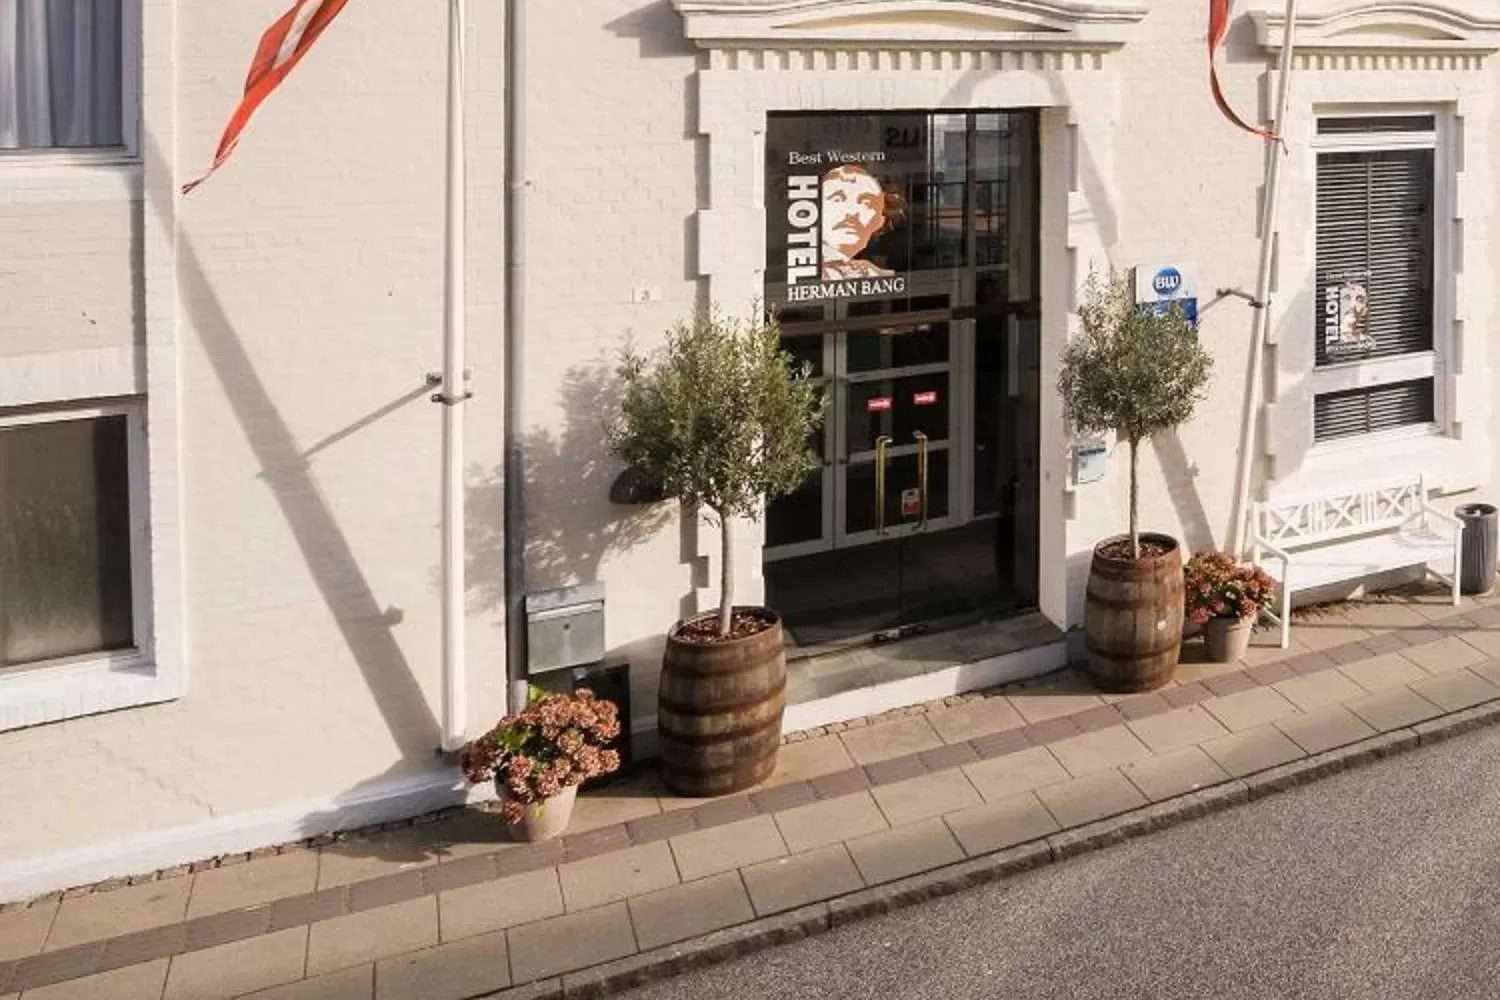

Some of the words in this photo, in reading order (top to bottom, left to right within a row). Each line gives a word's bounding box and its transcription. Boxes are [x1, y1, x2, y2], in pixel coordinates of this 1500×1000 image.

[788, 151, 822, 165] Best
[826, 150, 885, 164] Western
[787, 175, 819, 285] HOTEL
[787, 281, 857, 302] HERMAN
[861, 277, 905, 295] BANG
[1325, 286, 1339, 345] HOTEL
